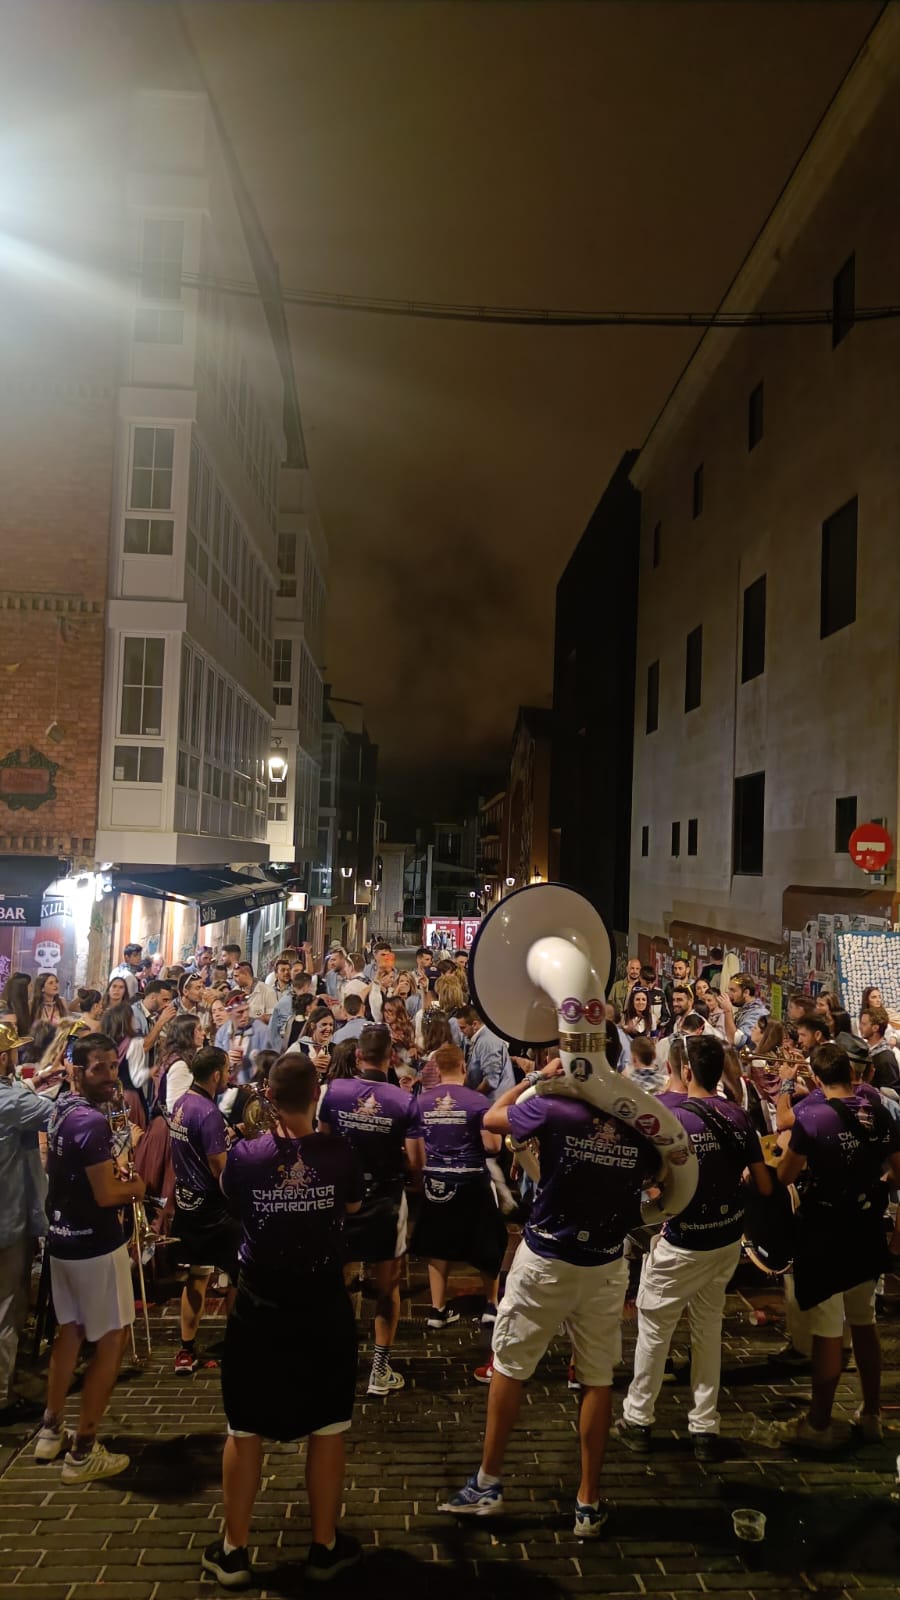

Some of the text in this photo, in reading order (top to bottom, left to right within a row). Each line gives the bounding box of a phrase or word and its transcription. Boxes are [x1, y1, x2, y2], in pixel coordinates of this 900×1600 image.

[0, 907, 26, 920] BAR
[564, 1135, 639, 1158] CHARANGA
[563, 1147, 637, 1169] TXIPIRONES
[251, 1184, 335, 1200] CHARANGA
[252, 1198, 335, 1213] TXIPIRONES
